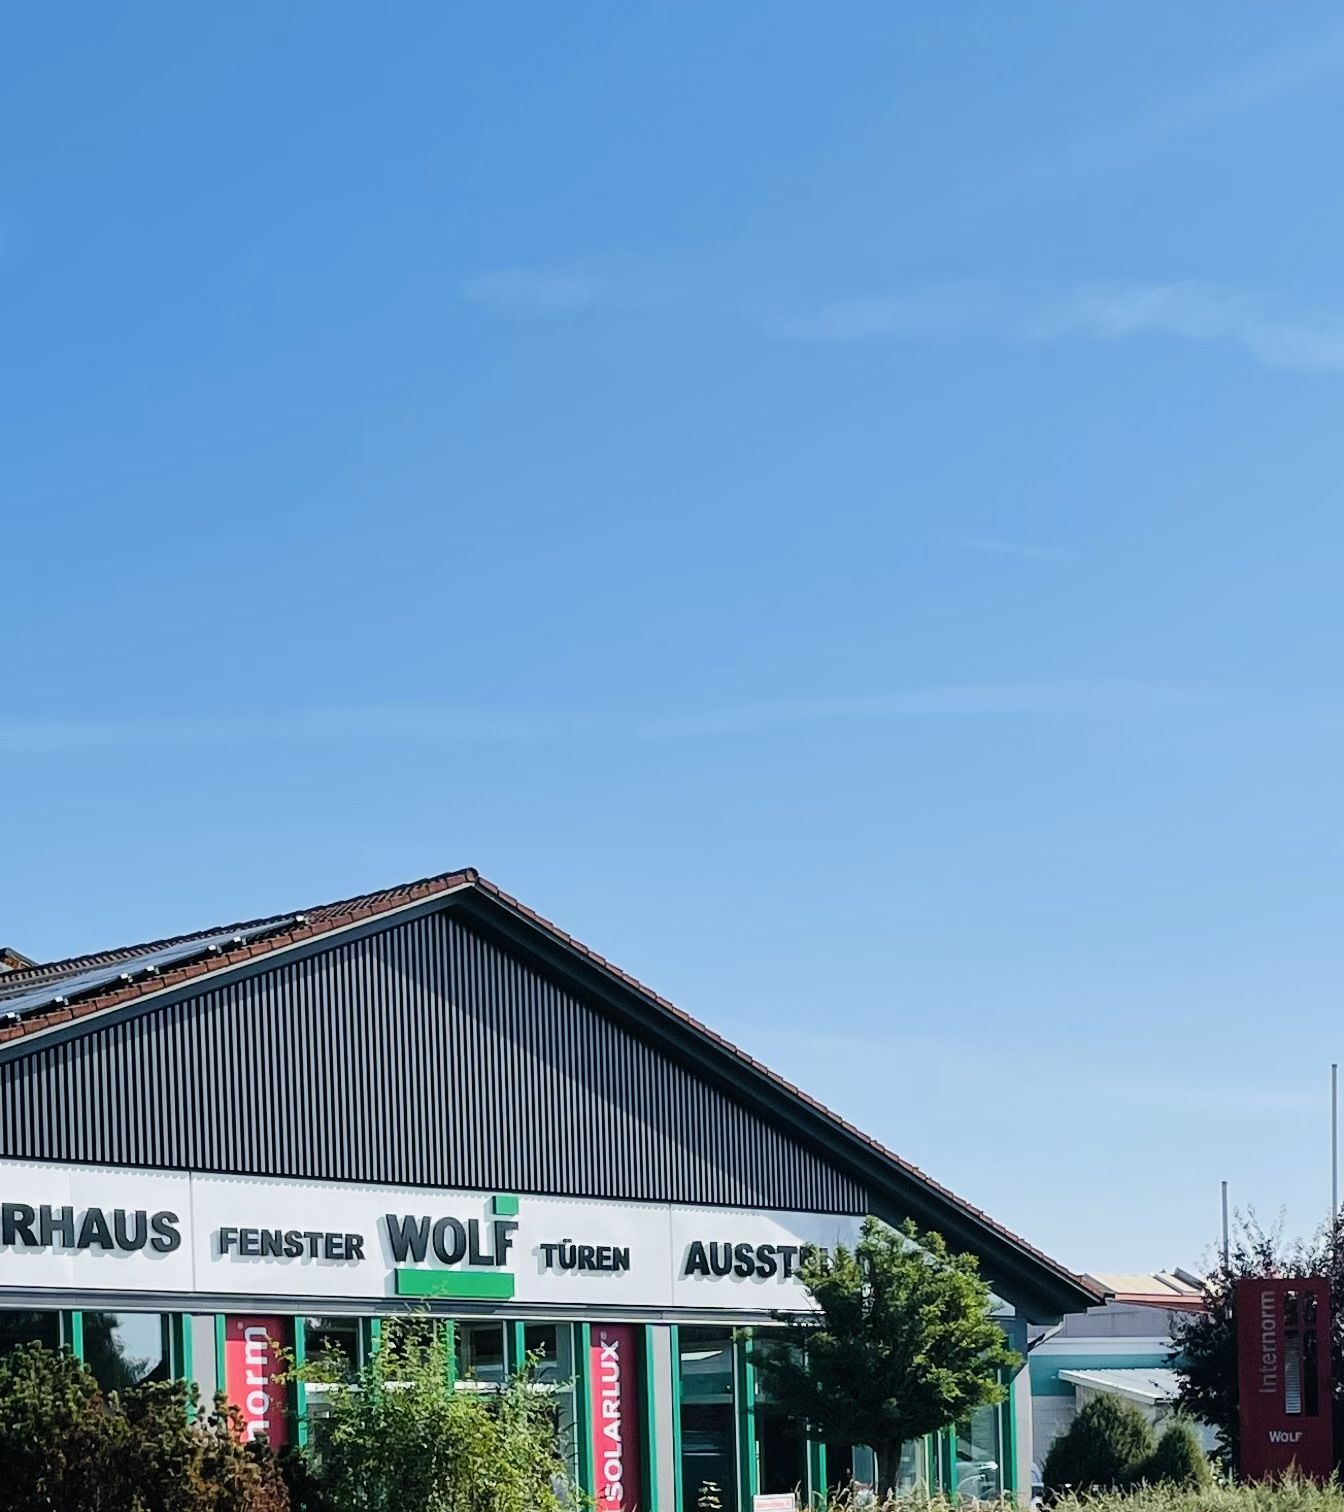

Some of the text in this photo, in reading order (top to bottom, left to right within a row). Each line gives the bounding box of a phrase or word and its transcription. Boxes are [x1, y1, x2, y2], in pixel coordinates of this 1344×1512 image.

[219, 1226, 367, 1261] FENSTER
[385, 1213, 519, 1267] WOLF
[539, 1238, 632, 1272] TÜREN
[1258, 1290, 1278, 1394] Internorm
[1269, 1430, 1303, 1443] WOLF
